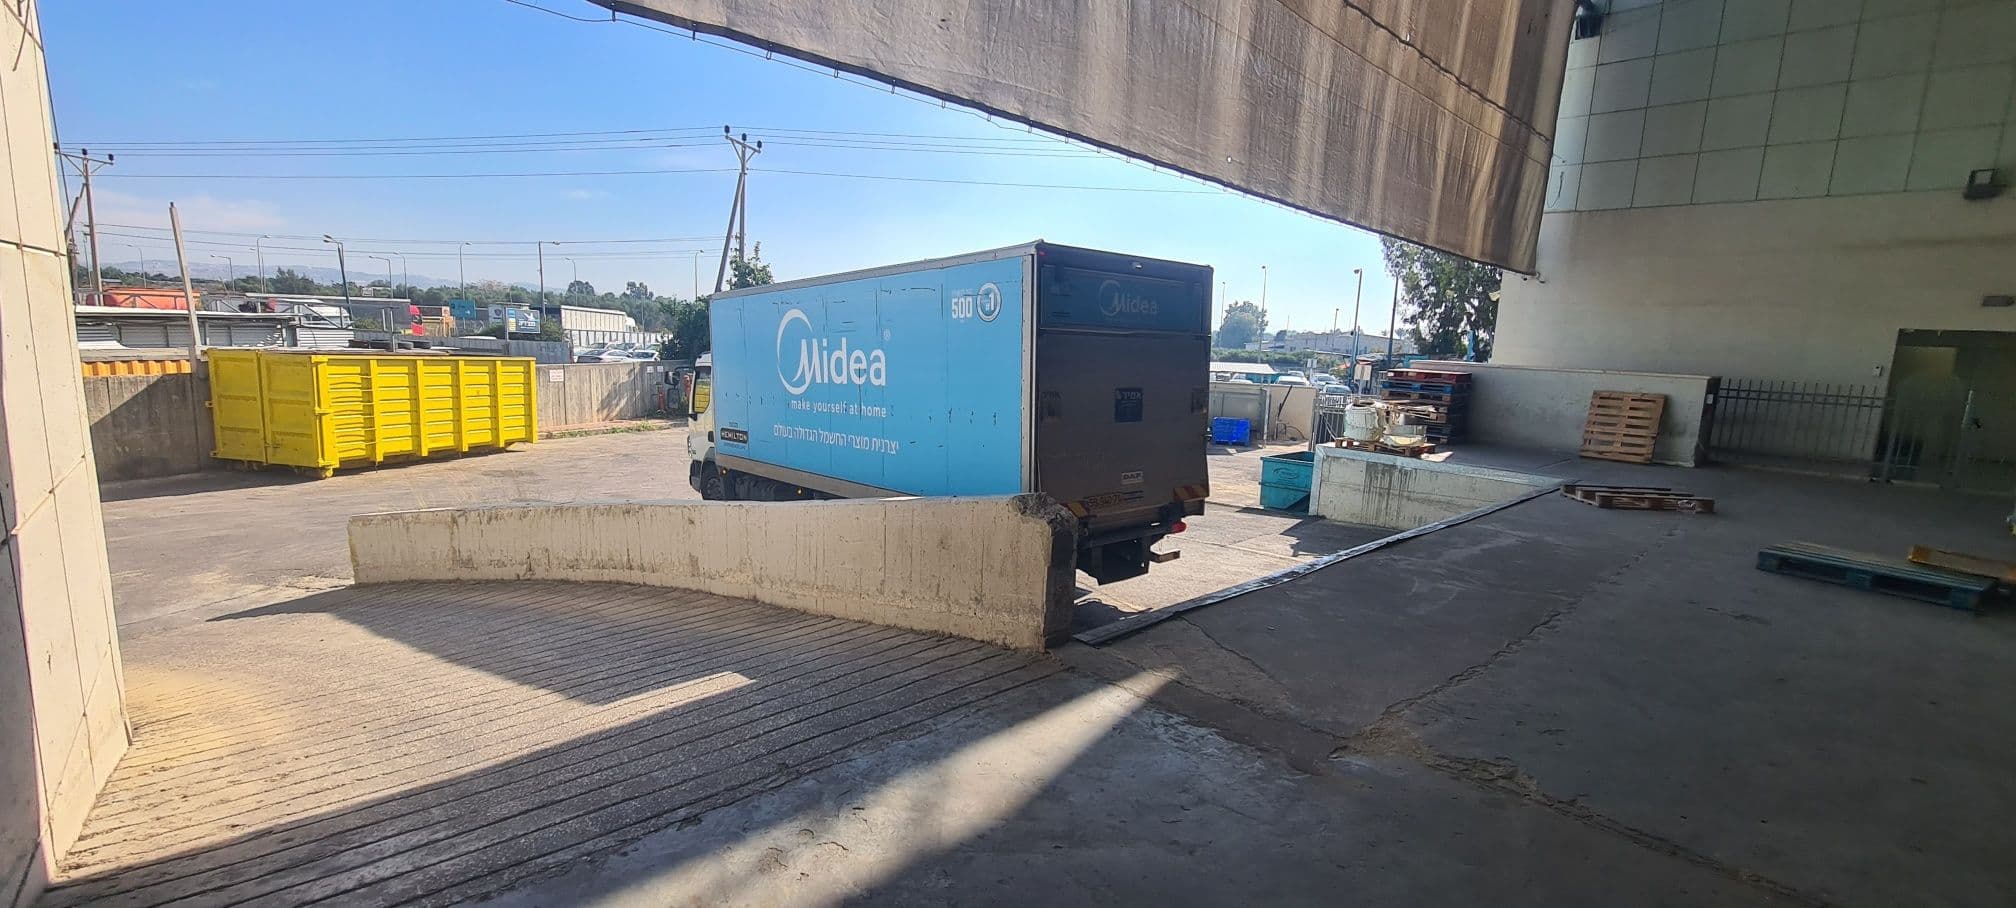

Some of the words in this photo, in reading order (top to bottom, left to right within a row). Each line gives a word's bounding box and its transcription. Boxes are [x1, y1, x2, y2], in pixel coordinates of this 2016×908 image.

[951, 296, 973, 319] 500
[1099, 280, 1160, 316] Midea
[777, 309, 886, 395] Midea
[791, 399, 811, 411] make
[813, 401, 847, 413] yourself
[849, 404, 858, 415] at
[861, 404, 887, 418] home
[773, 423, 793, 439] בעולם
[793, 425, 818, 443] הגדולה
[819, 427, 847, 447] החשמל
[847, 434, 869, 449] מוצרי
[871, 435, 899, 455] יצרנית
